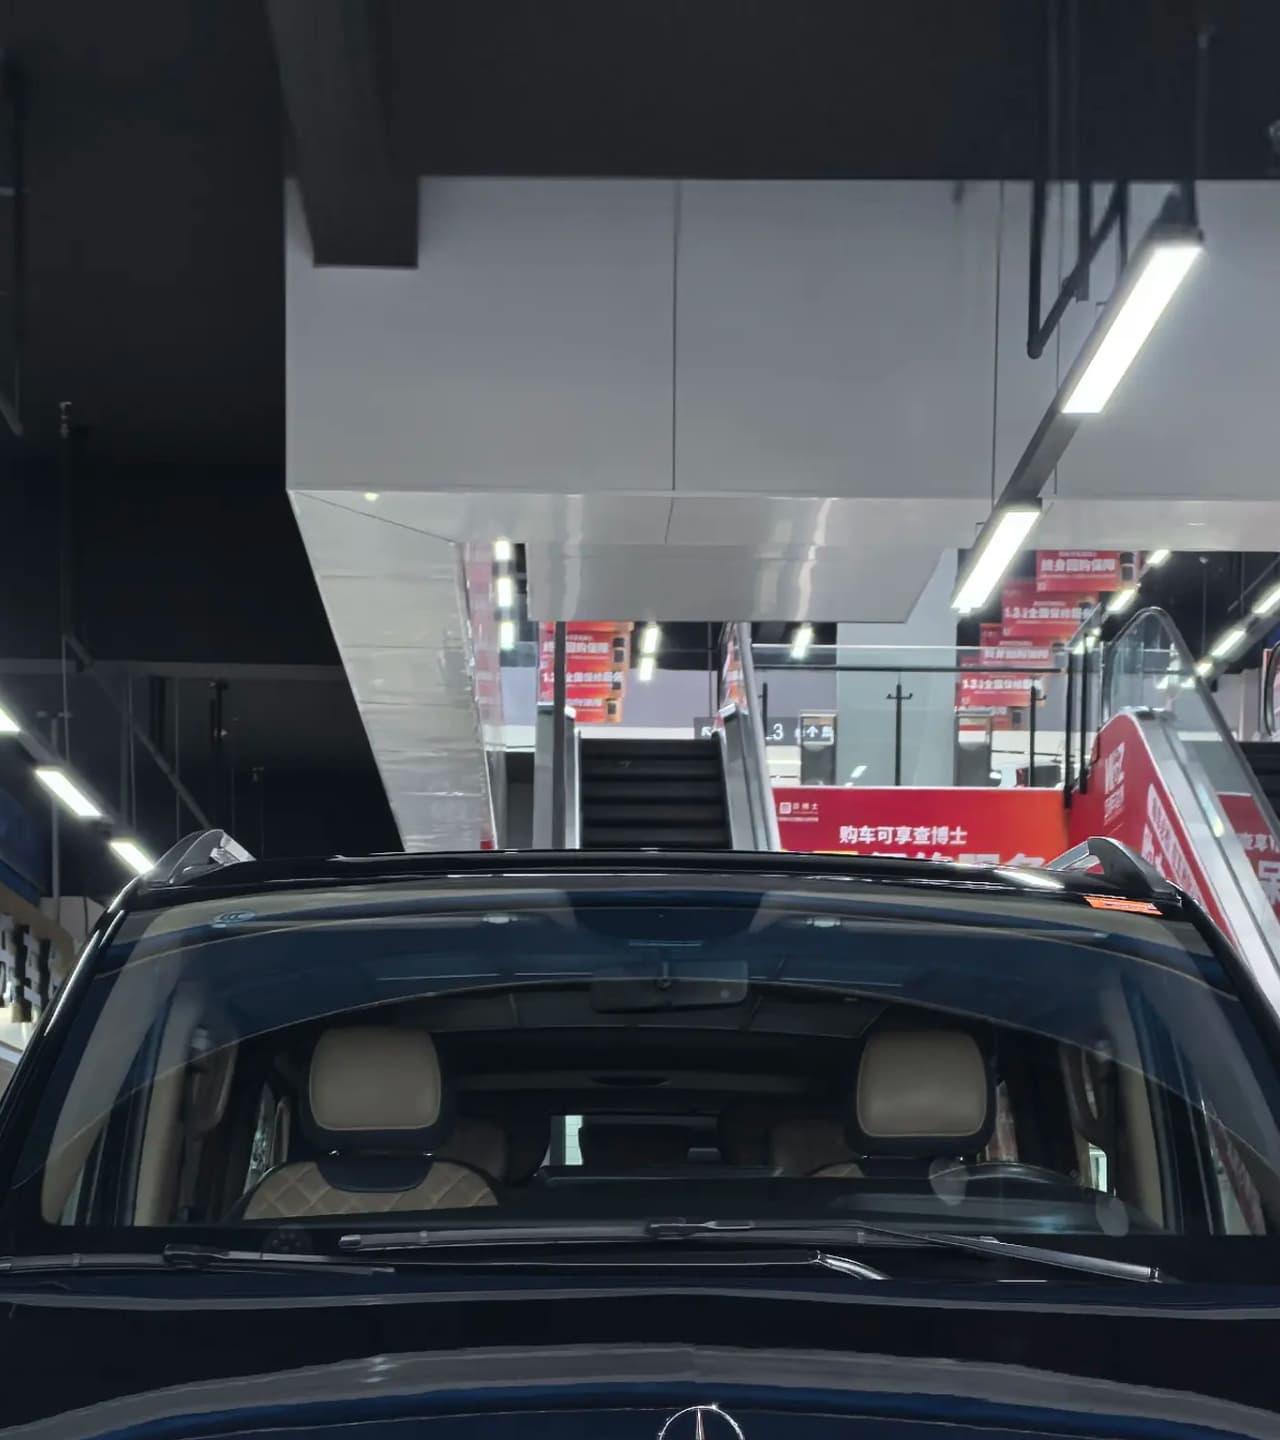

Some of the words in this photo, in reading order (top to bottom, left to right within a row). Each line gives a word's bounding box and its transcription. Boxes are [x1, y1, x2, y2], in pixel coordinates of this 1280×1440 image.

[839, 825, 969, 846] 购车可享查博士
